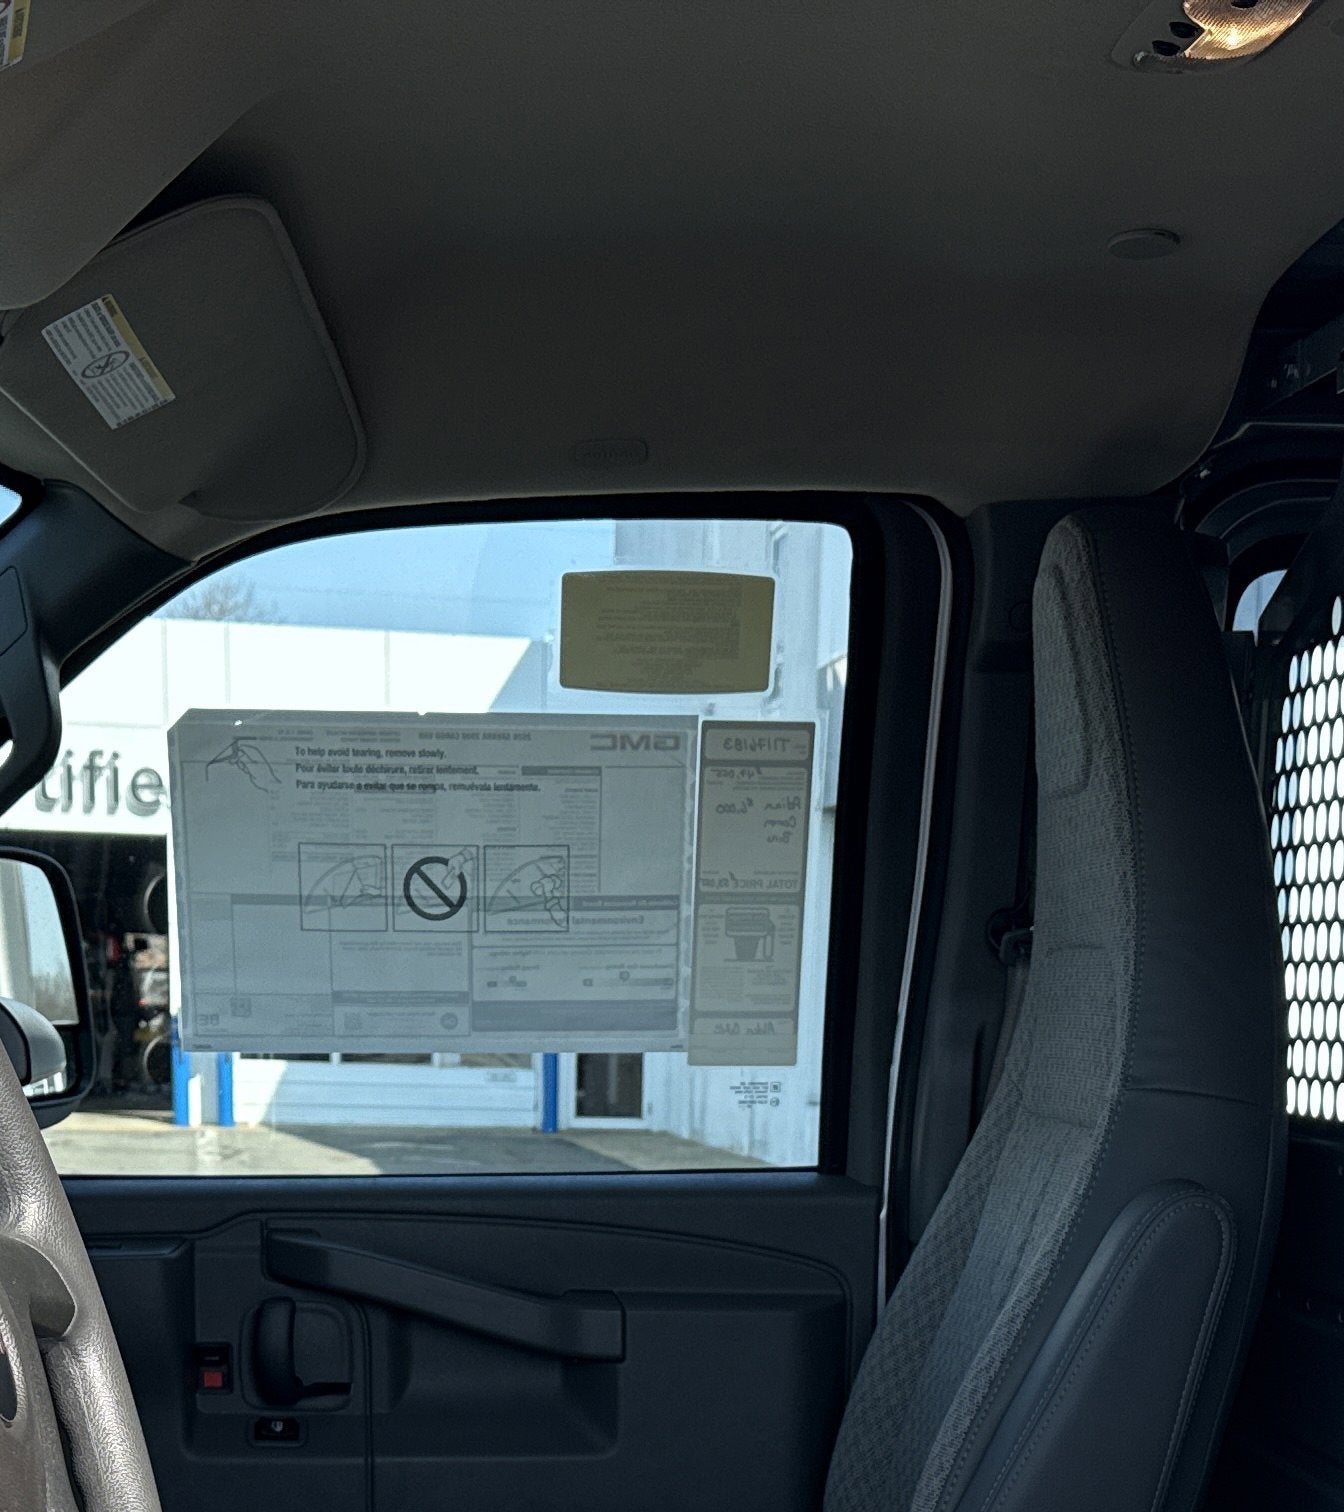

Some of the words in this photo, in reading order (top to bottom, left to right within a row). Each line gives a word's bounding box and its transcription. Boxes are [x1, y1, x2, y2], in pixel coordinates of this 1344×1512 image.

[307, 747, 325, 759] help
[327, 748, 350, 757] avoid
[385, 750, 416, 758] remove
